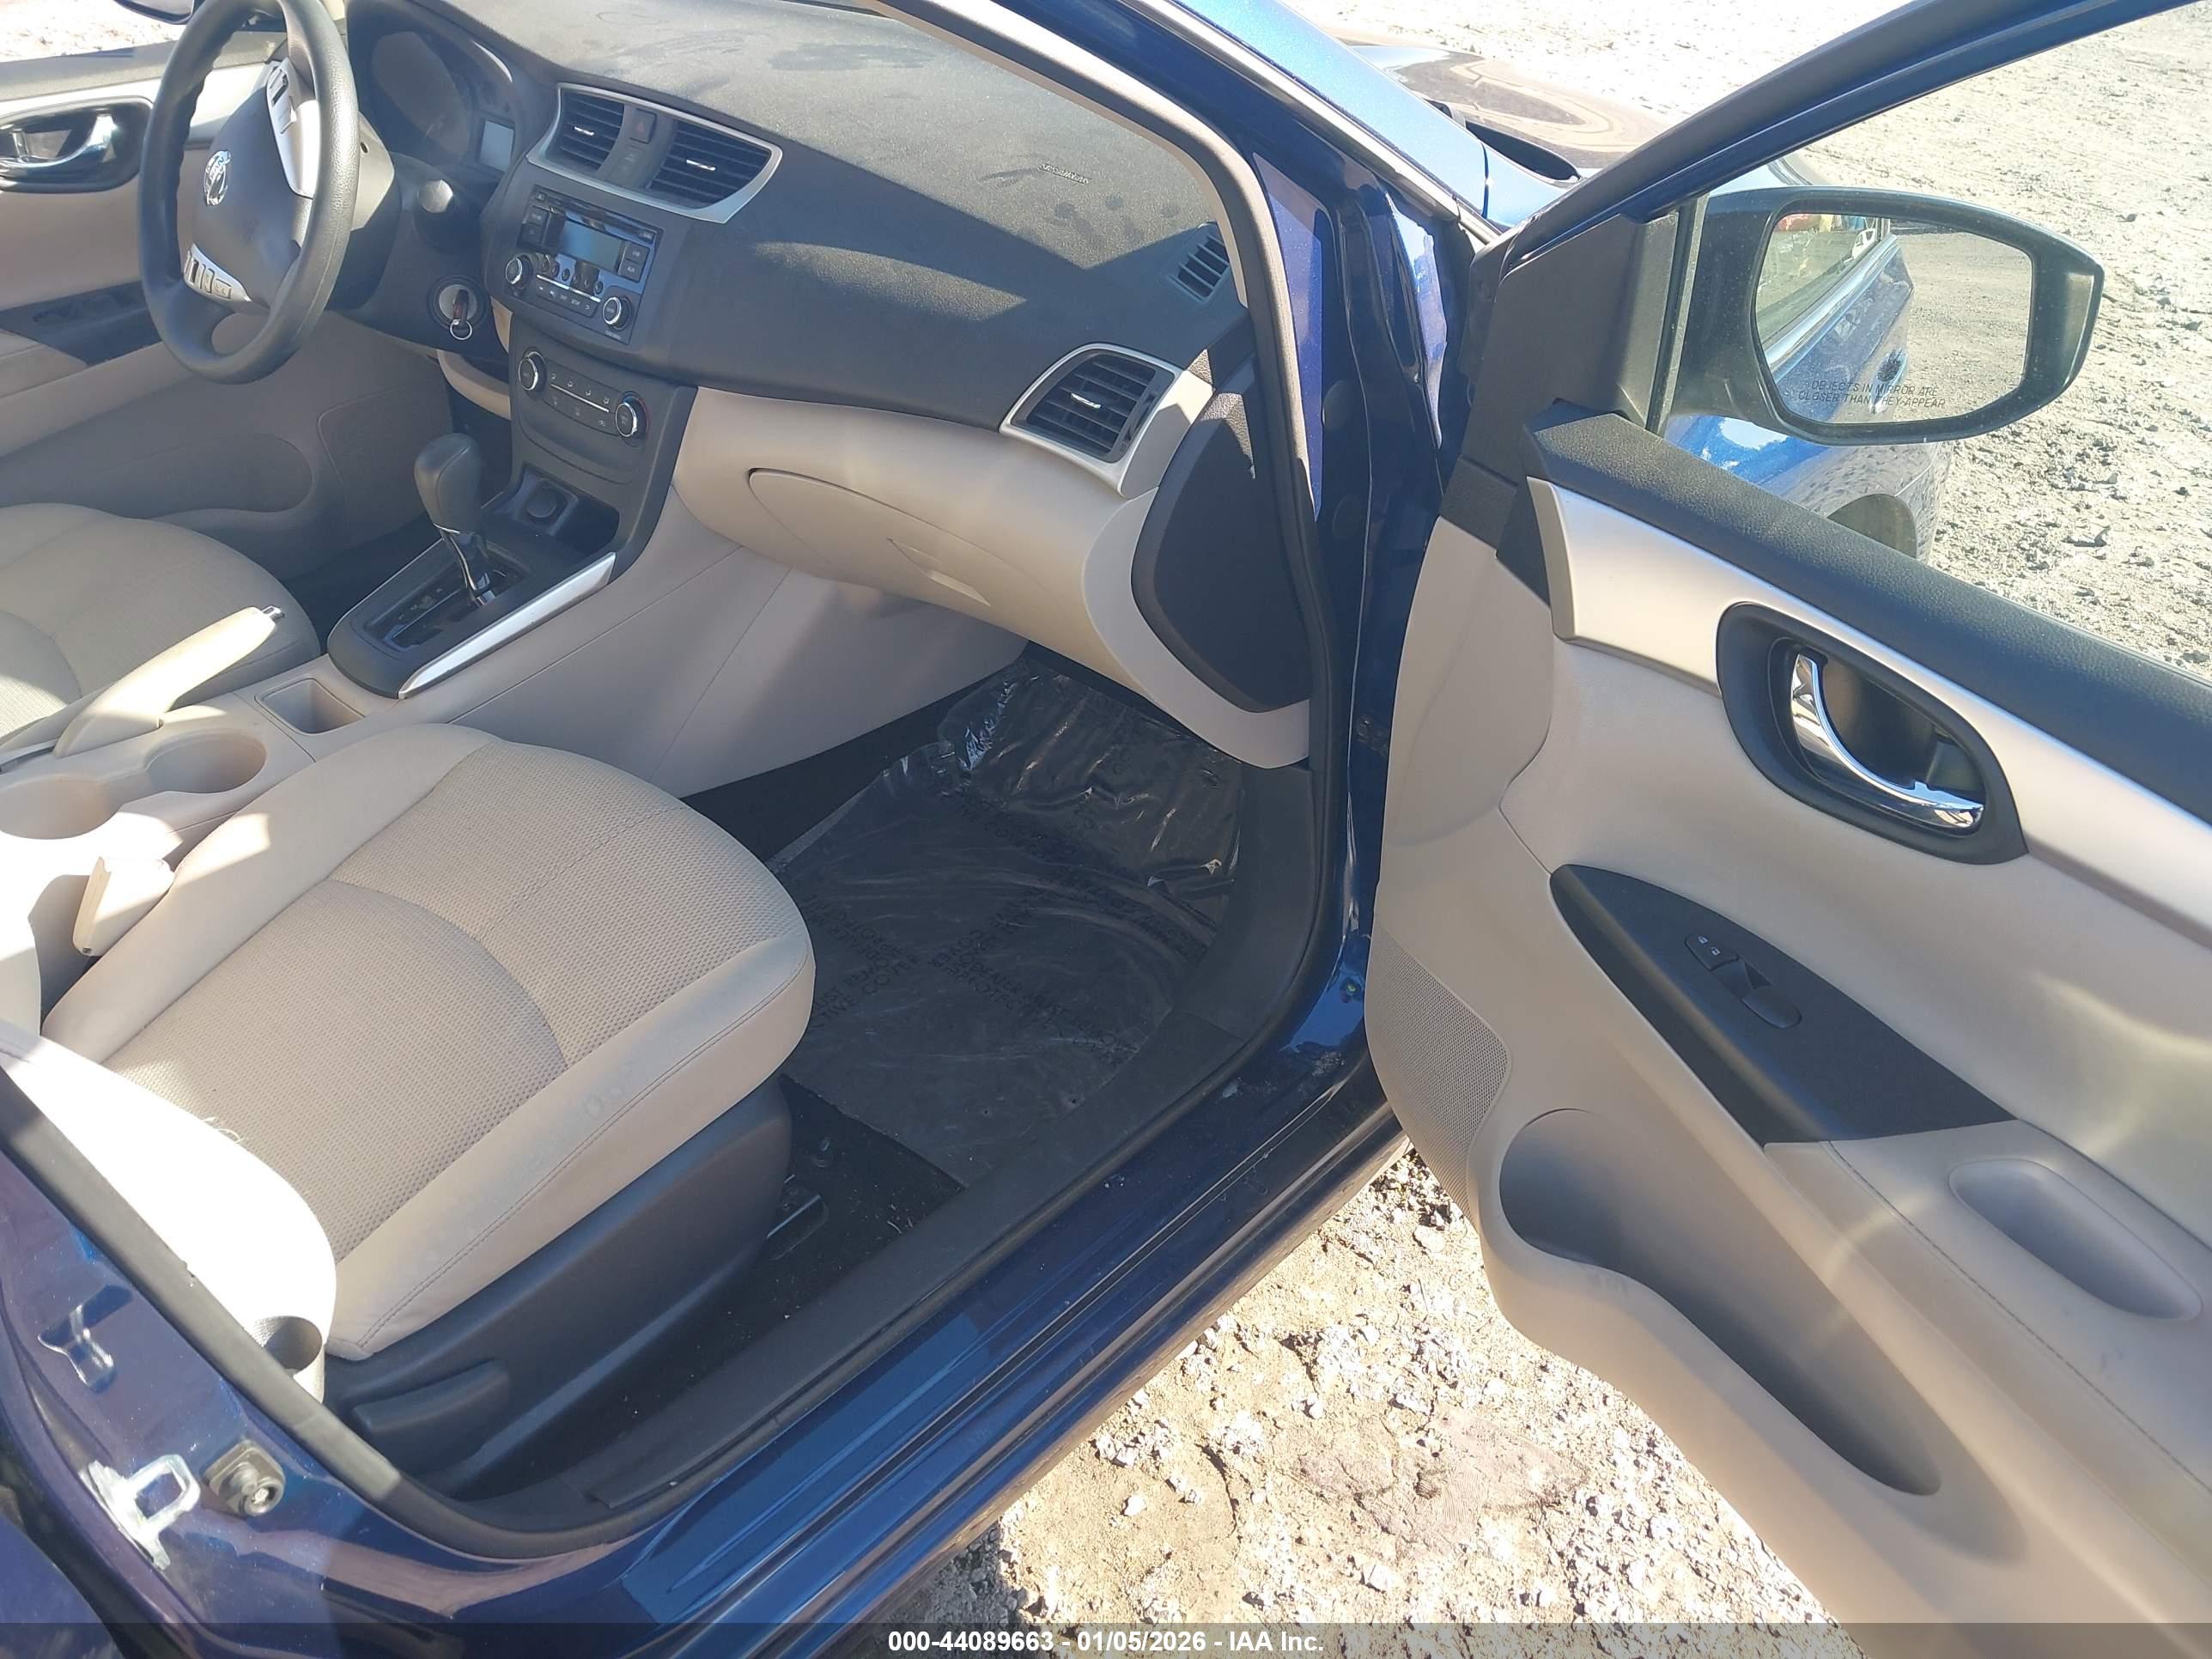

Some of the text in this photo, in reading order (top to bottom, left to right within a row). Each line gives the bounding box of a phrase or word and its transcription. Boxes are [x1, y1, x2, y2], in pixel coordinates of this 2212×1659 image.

[1811, 380, 1938, 397] OBJECTS IN MIRROR ARE
[1798, 391, 1946, 409] CLOSER THAN THEY APPEAR
